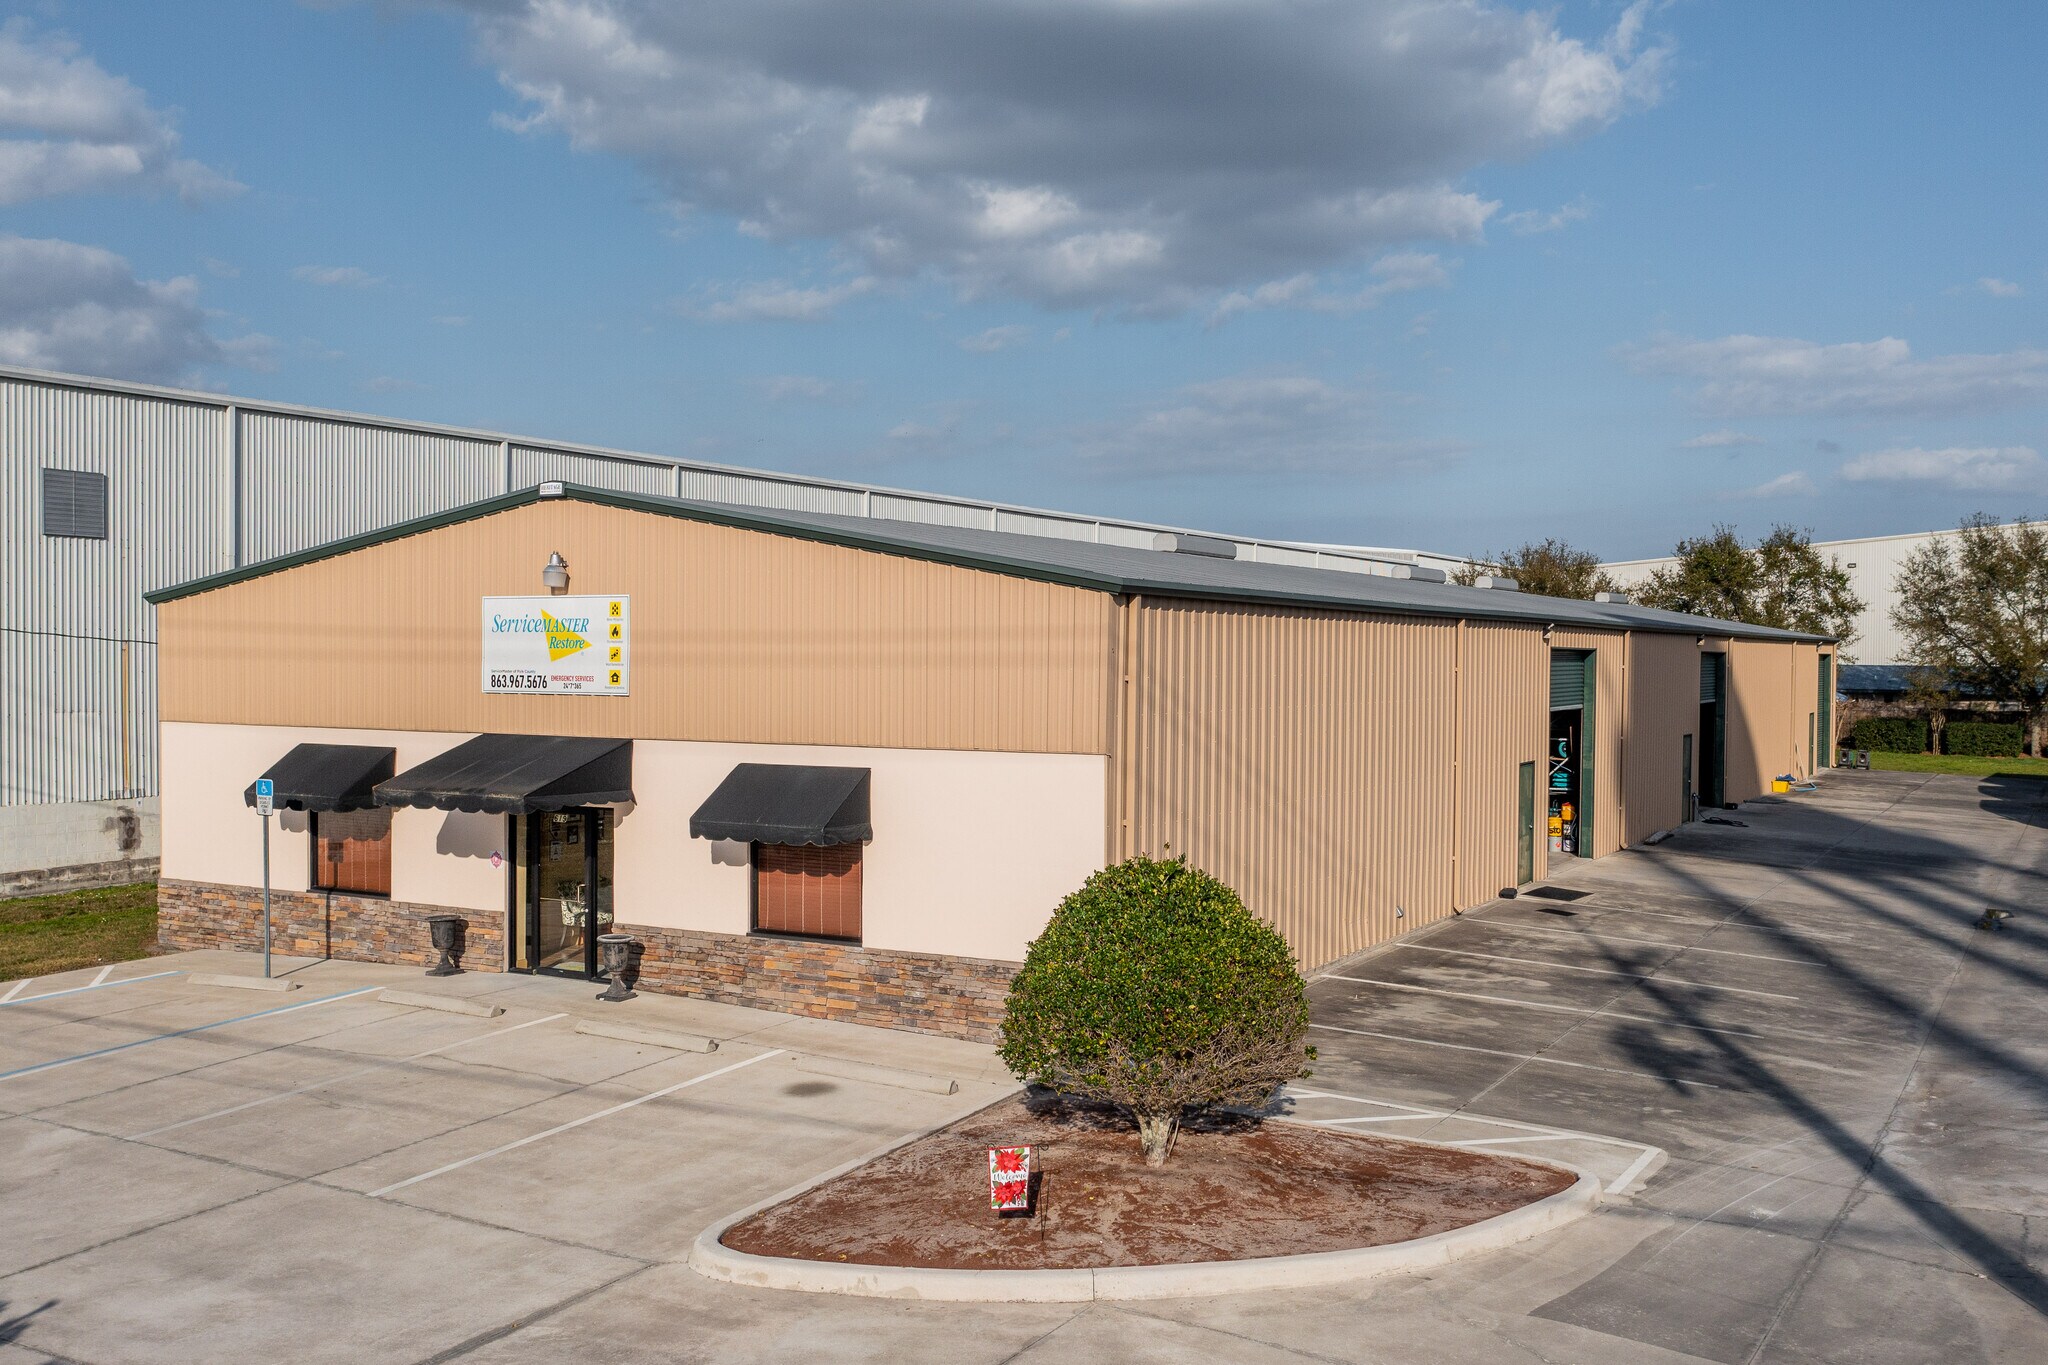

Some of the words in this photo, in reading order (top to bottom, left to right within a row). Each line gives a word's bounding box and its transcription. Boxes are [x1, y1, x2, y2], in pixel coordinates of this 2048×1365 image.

[492, 614, 589, 633] ServiceMASTER
[549, 636, 585, 649] Restore
[491, 674, 548, 689] 863.967.5676
[575, 675, 594, 683] SERVICES
